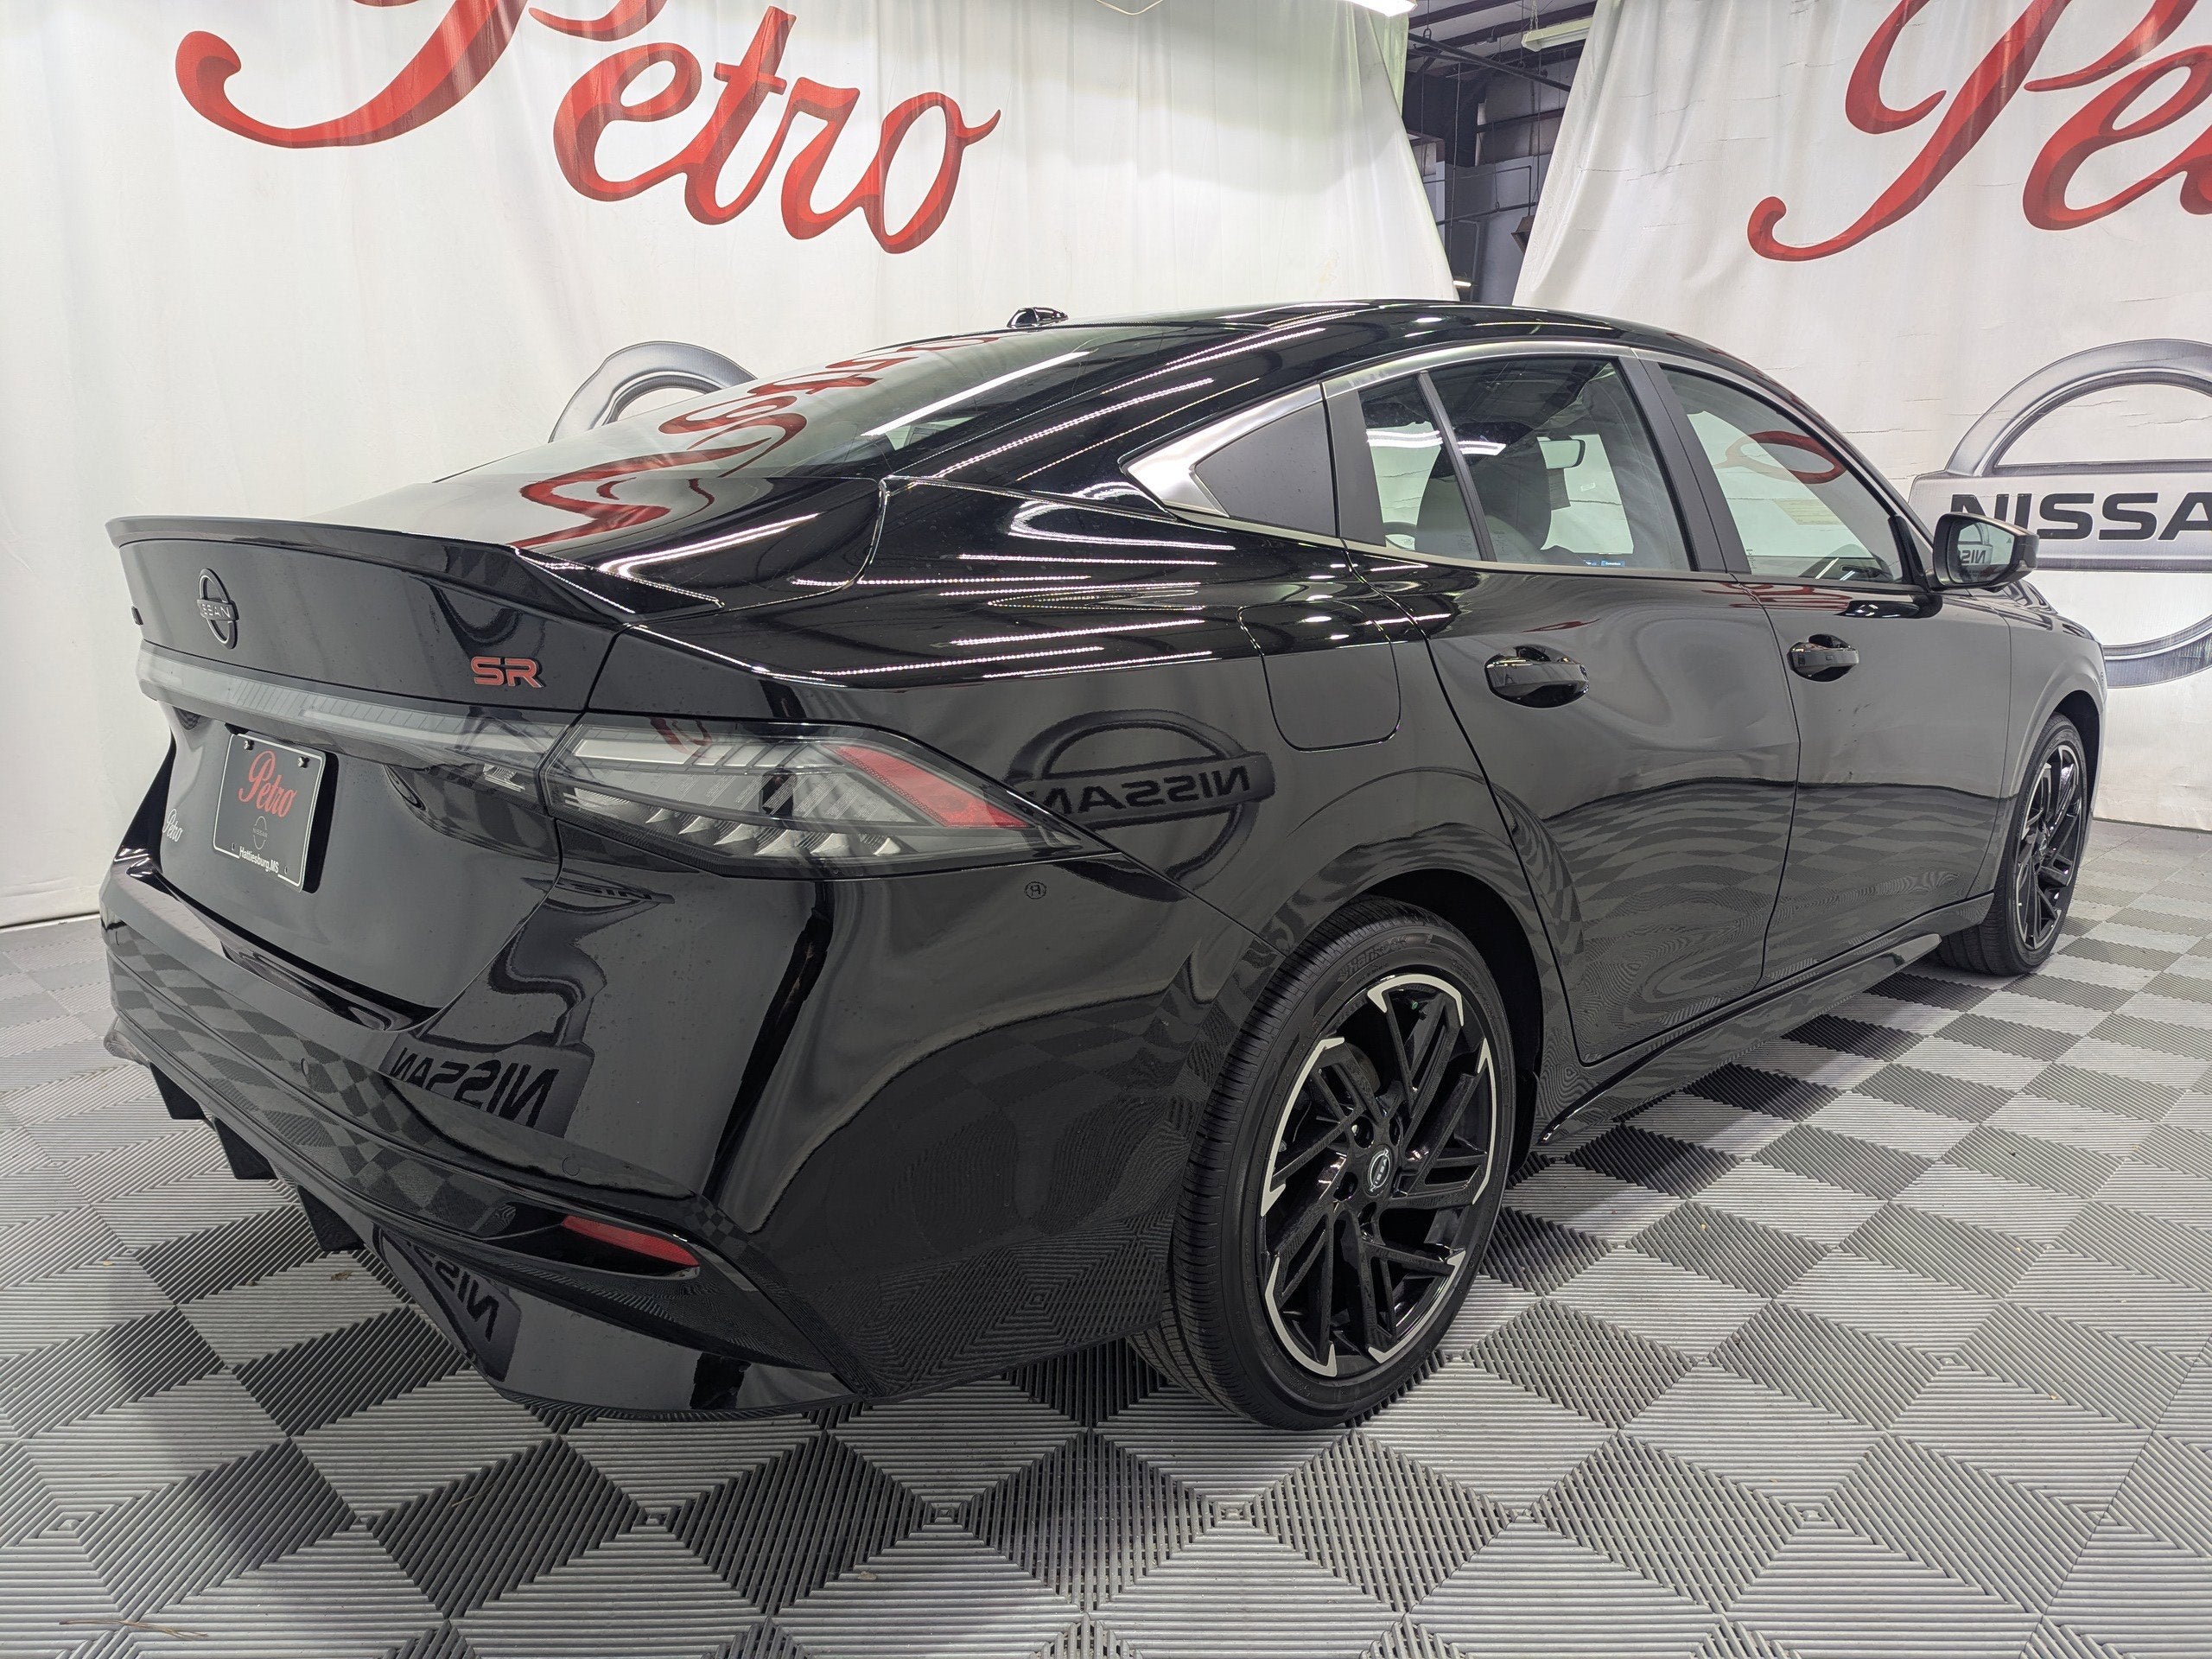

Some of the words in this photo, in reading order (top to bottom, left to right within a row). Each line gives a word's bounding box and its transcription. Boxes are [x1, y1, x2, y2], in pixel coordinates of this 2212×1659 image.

[471, 656, 543, 689] SR
[238, 749, 297, 818] Petro
[162, 808, 183, 842] Petro
